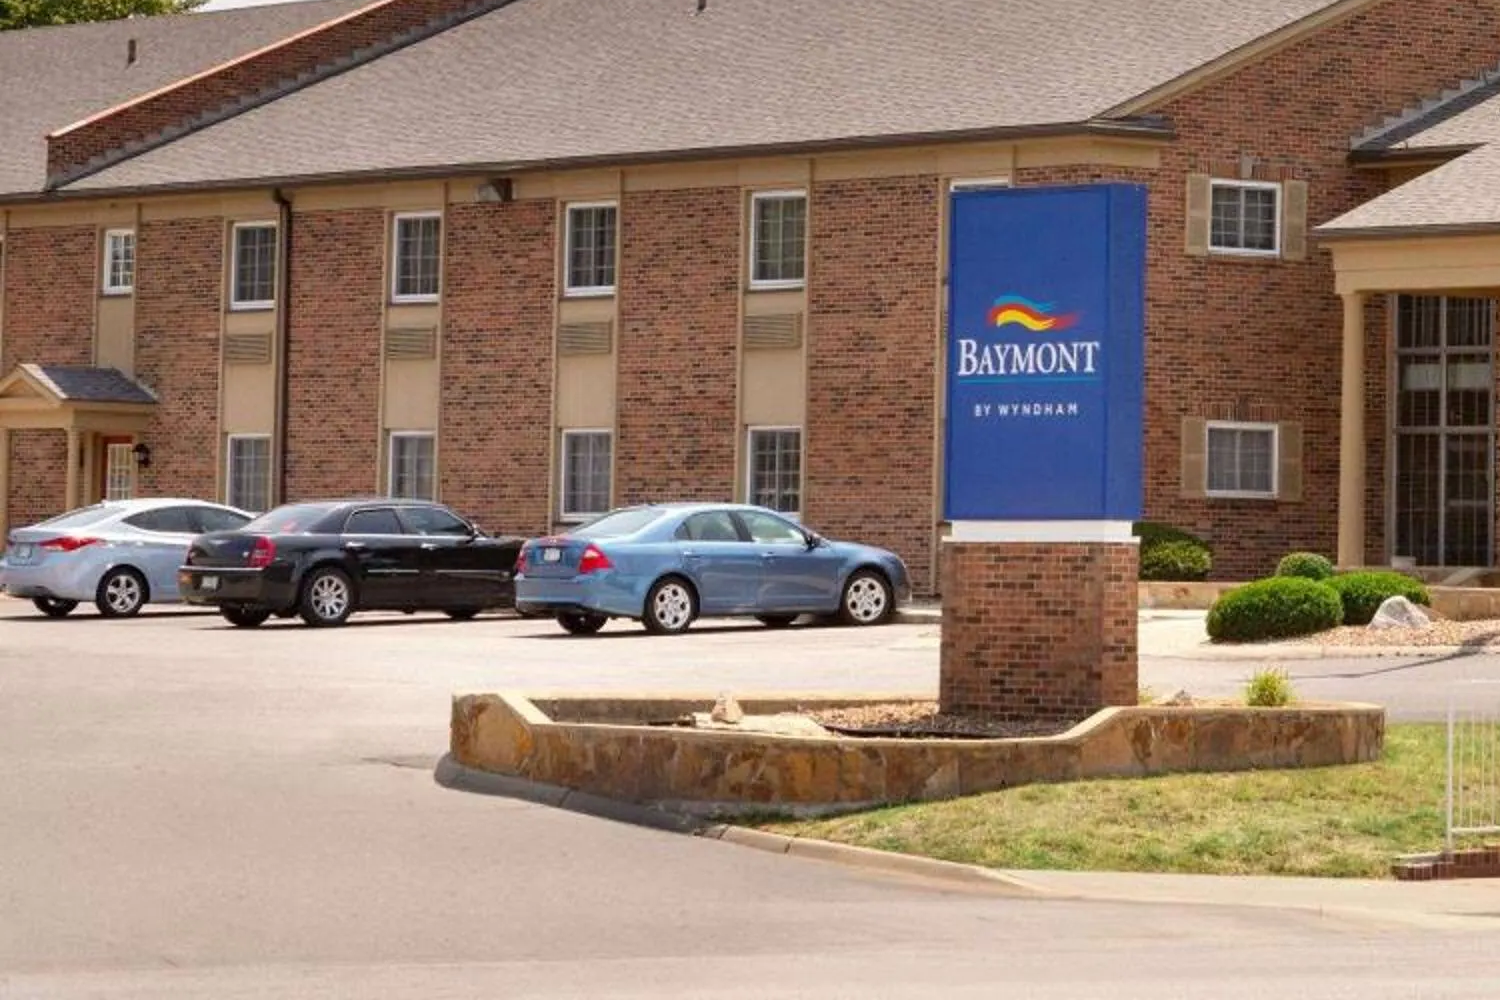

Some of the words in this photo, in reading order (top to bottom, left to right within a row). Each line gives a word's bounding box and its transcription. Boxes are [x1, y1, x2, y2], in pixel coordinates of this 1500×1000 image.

[957, 339, 1100, 377] BAYMONT
[974, 403, 991, 417] BY
[997, 403, 1078, 417] WYNDHAM
